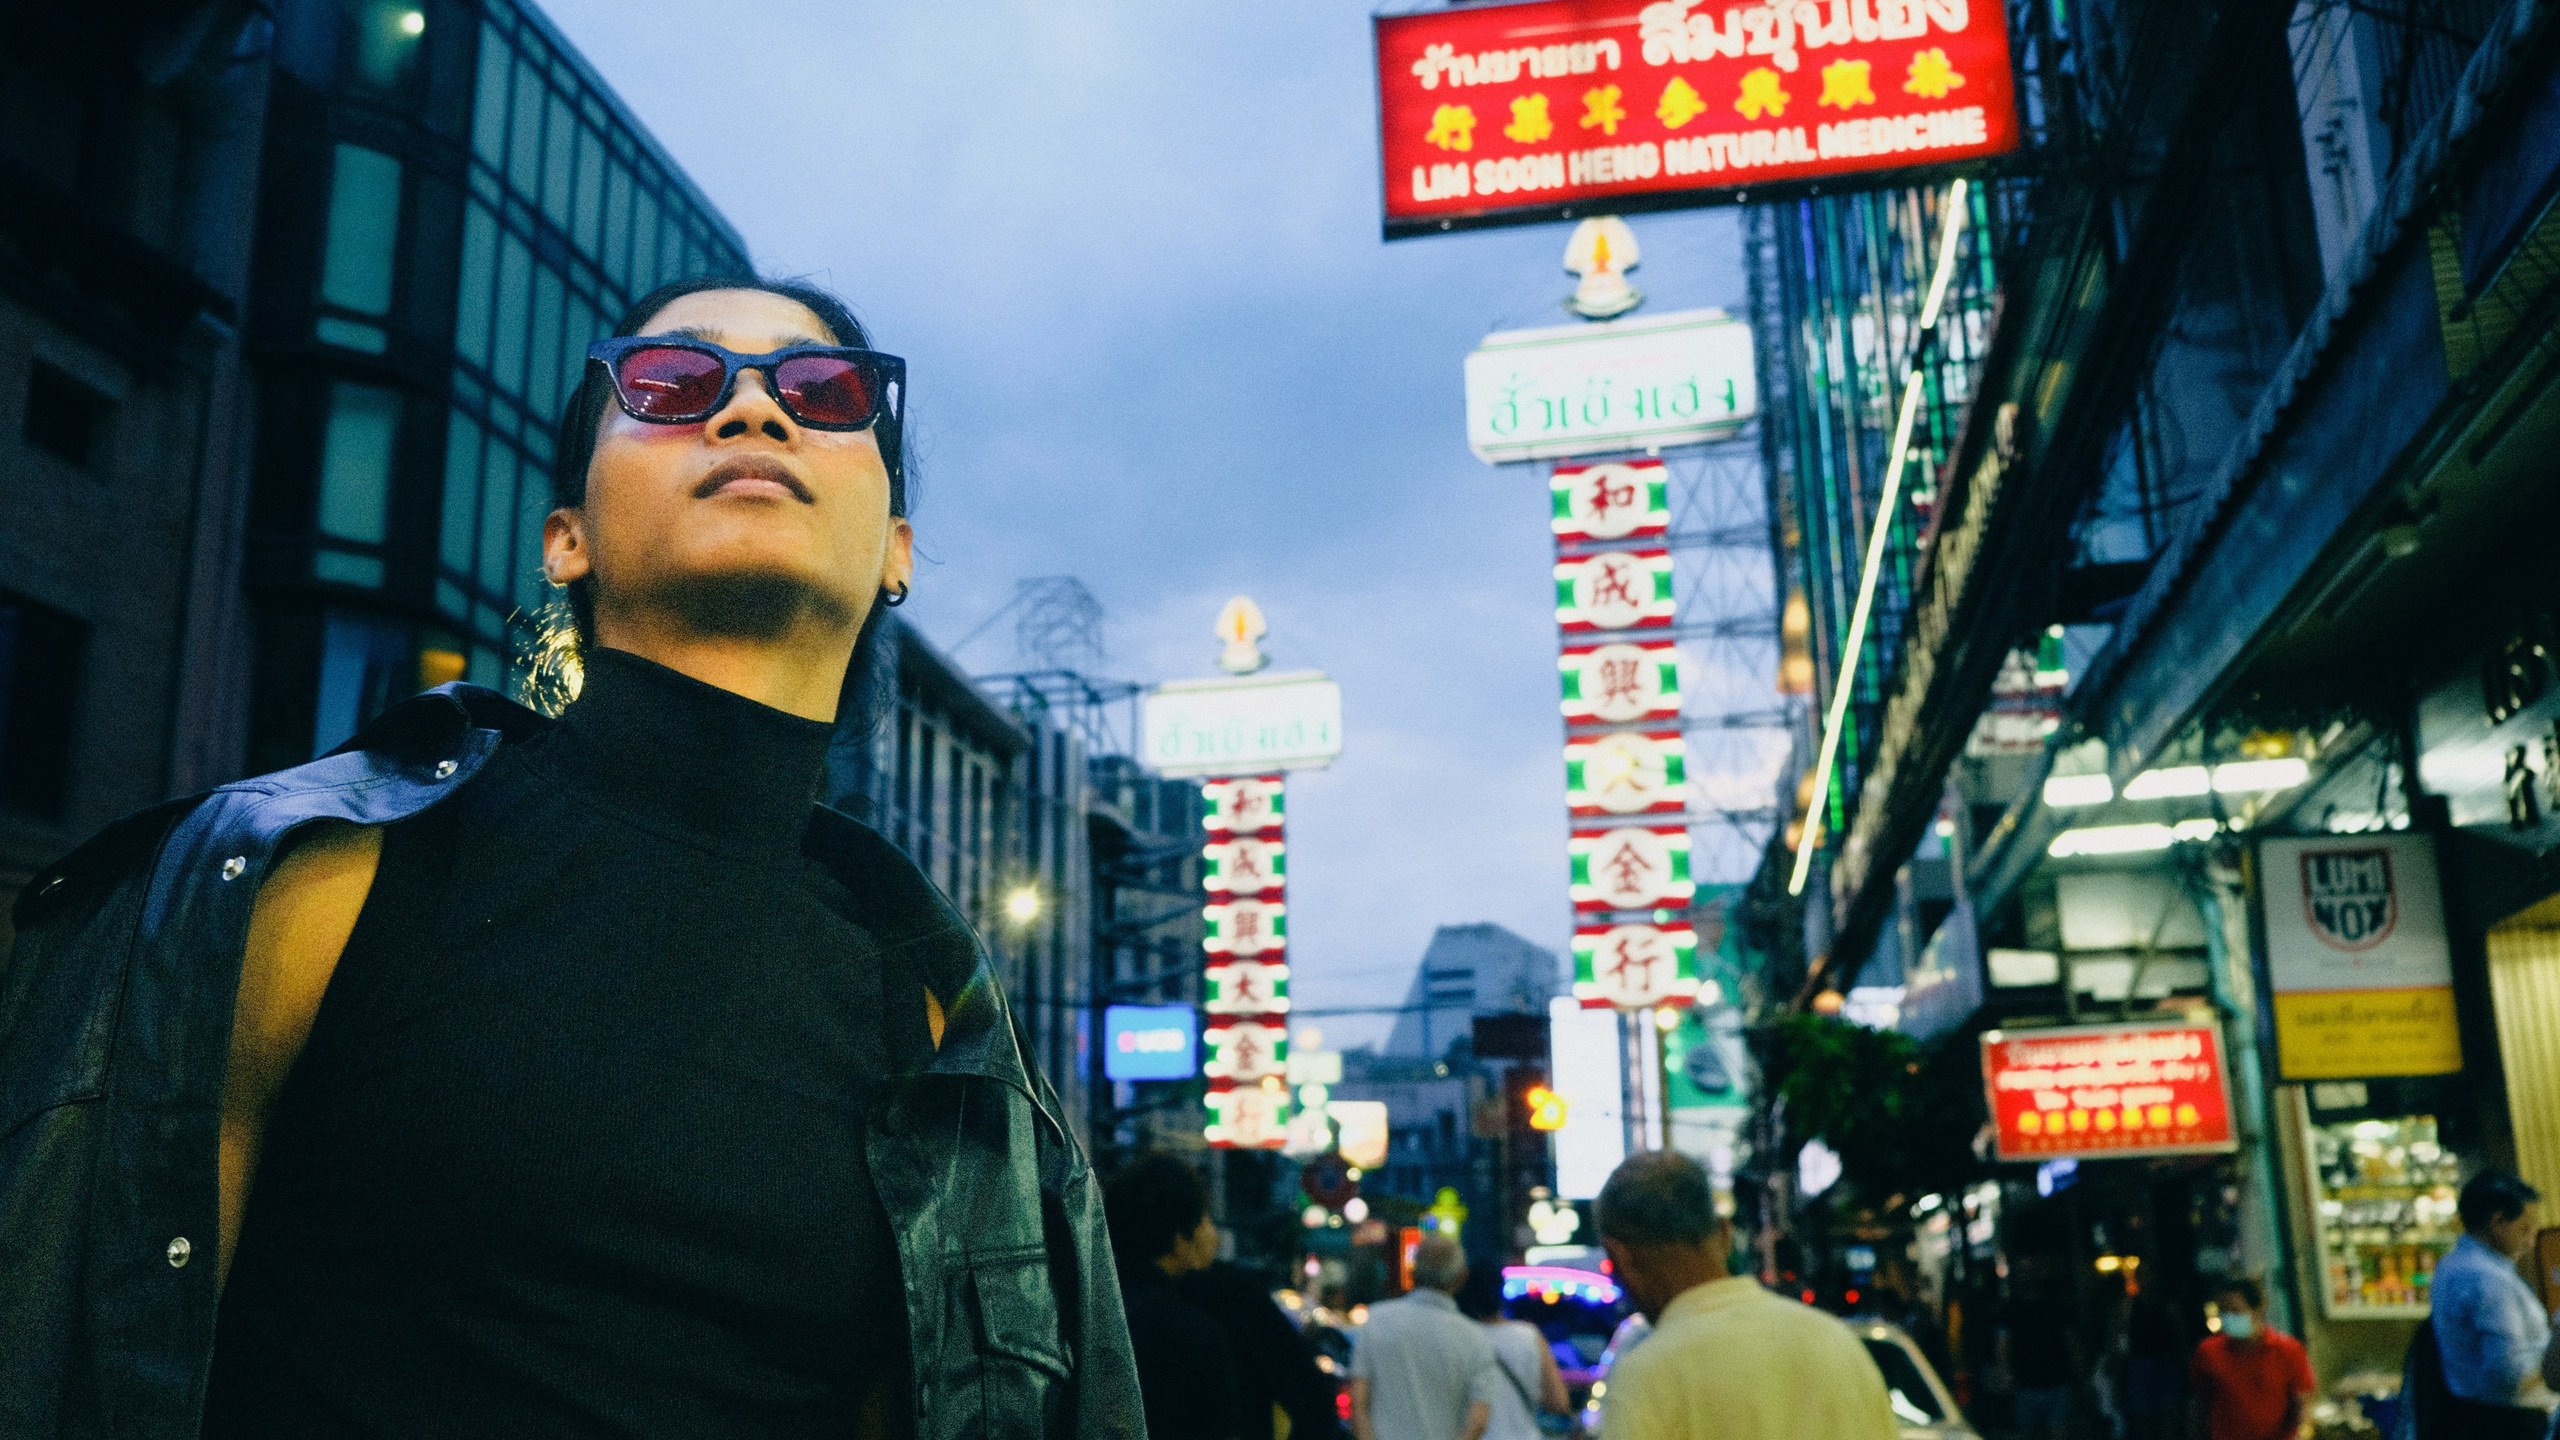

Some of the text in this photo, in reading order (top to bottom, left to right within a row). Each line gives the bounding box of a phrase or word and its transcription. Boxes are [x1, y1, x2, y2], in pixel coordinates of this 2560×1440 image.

[1411, 41, 1622, 91] ร้านขายยา
[1413, 105, 1988, 201] LIM SOON HENG NATURAL MEDICINE
[2308, 857, 2384, 895] LUMI
